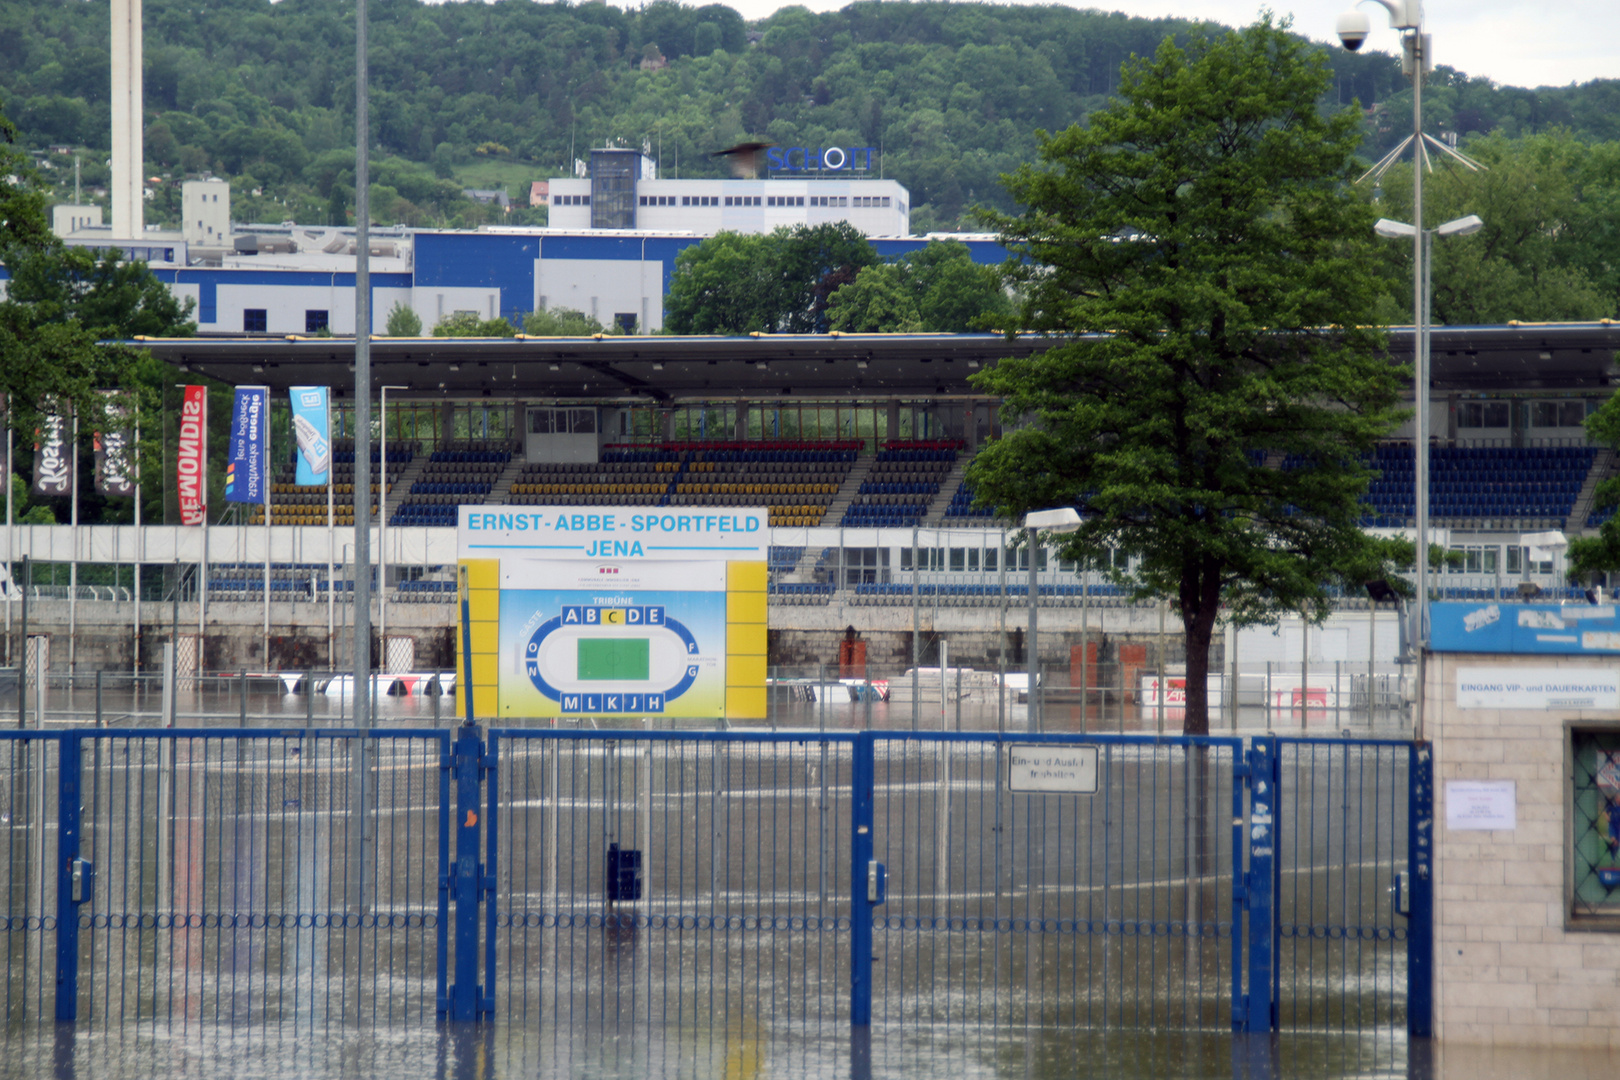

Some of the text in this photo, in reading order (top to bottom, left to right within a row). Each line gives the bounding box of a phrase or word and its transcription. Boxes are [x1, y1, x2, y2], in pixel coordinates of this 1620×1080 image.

[766, 147, 876, 170] SCHOTT
[586, 540, 644, 557] JENA
[592, 596, 633, 605] TRIBÜNE
[565, 608, 658, 623] A B C D E
[519, 609, 544, 638] GÄSTE
[528, 642, 538, 653] O
[688, 643, 695, 653] F
[528, 667, 537, 677] N
[688, 667, 697, 677] G
[1461, 684, 1503, 692] EINGANG
[1526, 684, 1543, 692] und
[1545, 684, 1616, 693] DAUERKARTEN
[564, 696, 659, 709] M L K J H
